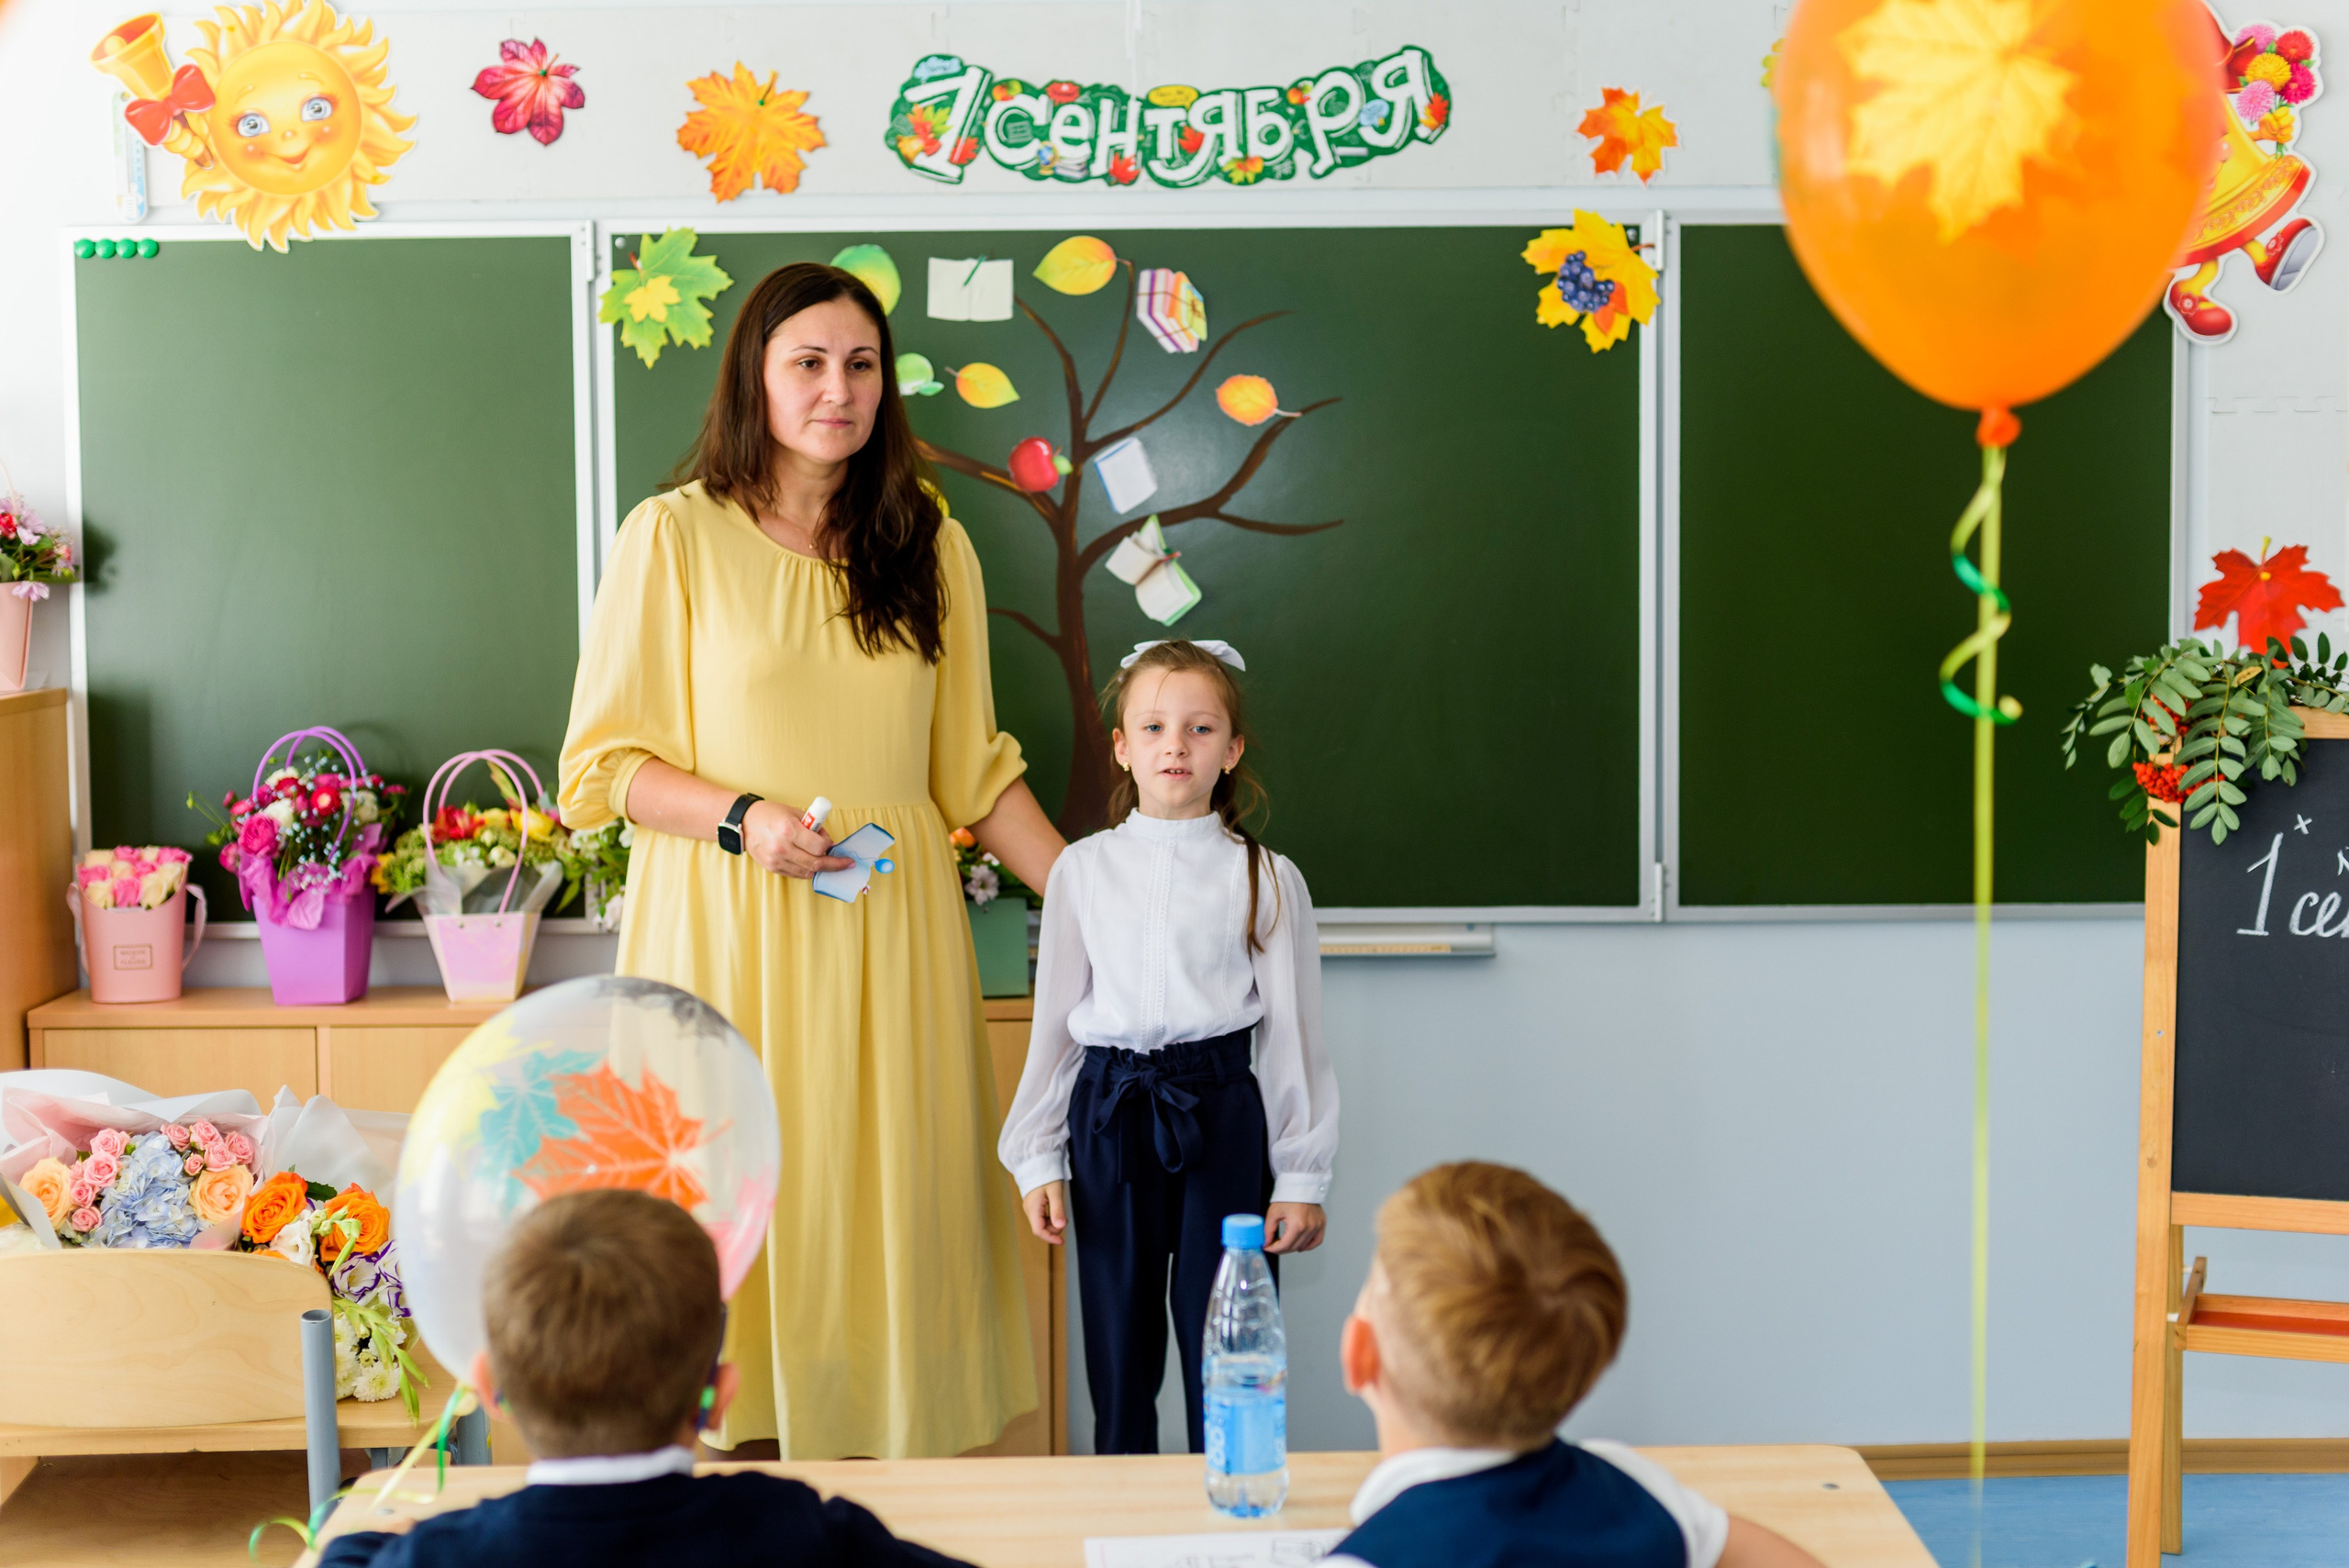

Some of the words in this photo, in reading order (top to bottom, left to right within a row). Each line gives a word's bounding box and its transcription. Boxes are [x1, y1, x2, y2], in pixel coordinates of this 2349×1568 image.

[903, 65, 985, 179] 1
[2236, 831, 2284, 936] 1
[2288, 891, 2349, 939] се
